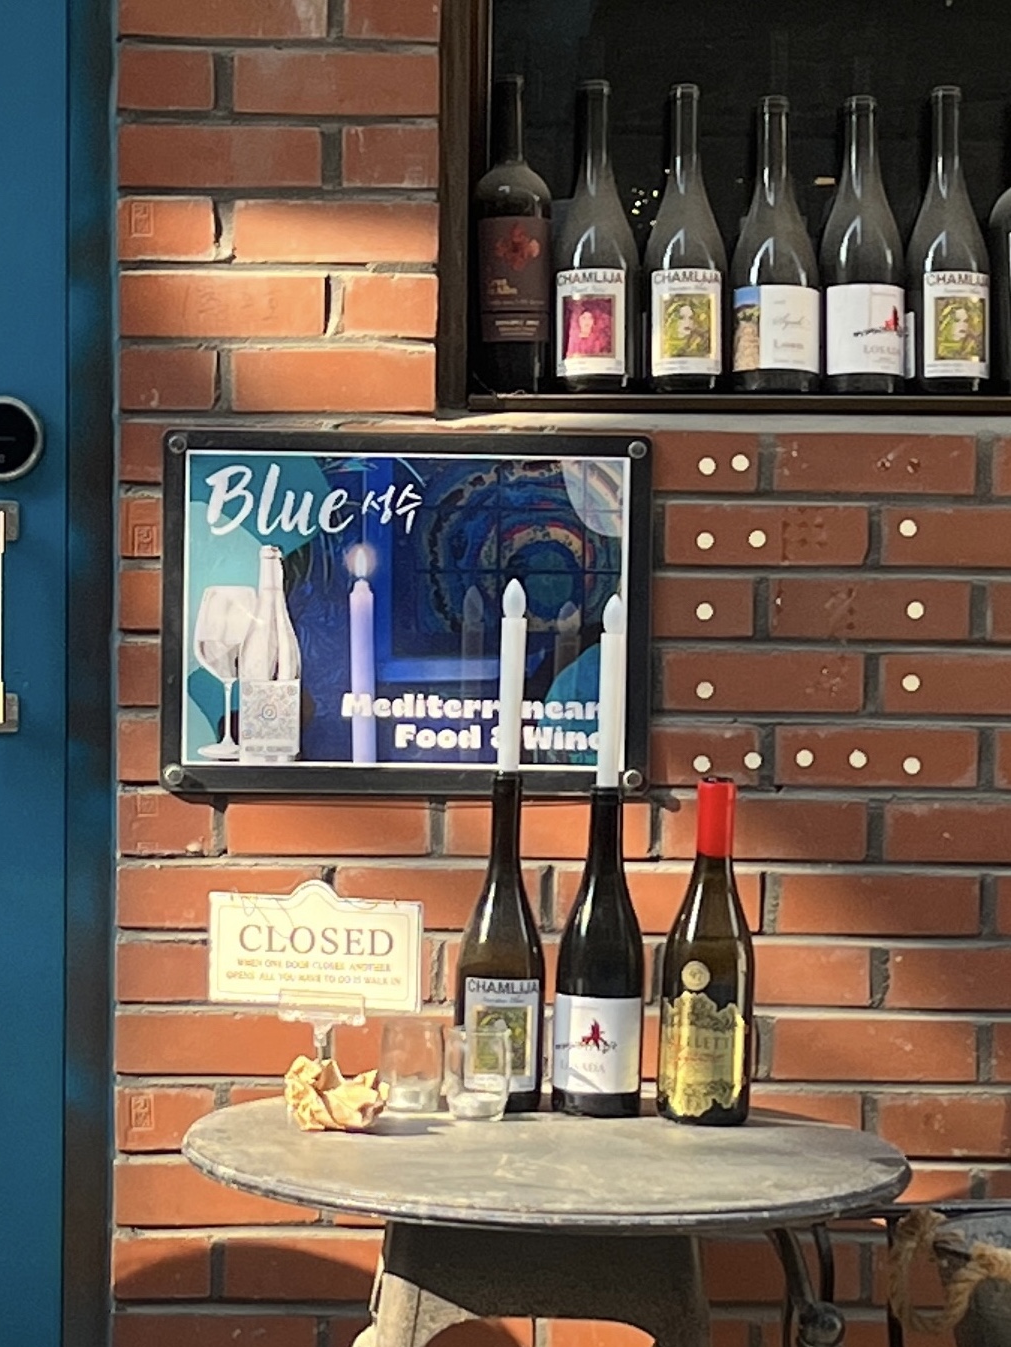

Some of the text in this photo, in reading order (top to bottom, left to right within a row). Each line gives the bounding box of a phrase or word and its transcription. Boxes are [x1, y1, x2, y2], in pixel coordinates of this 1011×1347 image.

[204, 463, 423, 536] Blue 성수
[340, 692, 601, 721] Mediterrnean
[394, 723, 482, 749] Food
[238, 924, 394, 957] CLOSED
